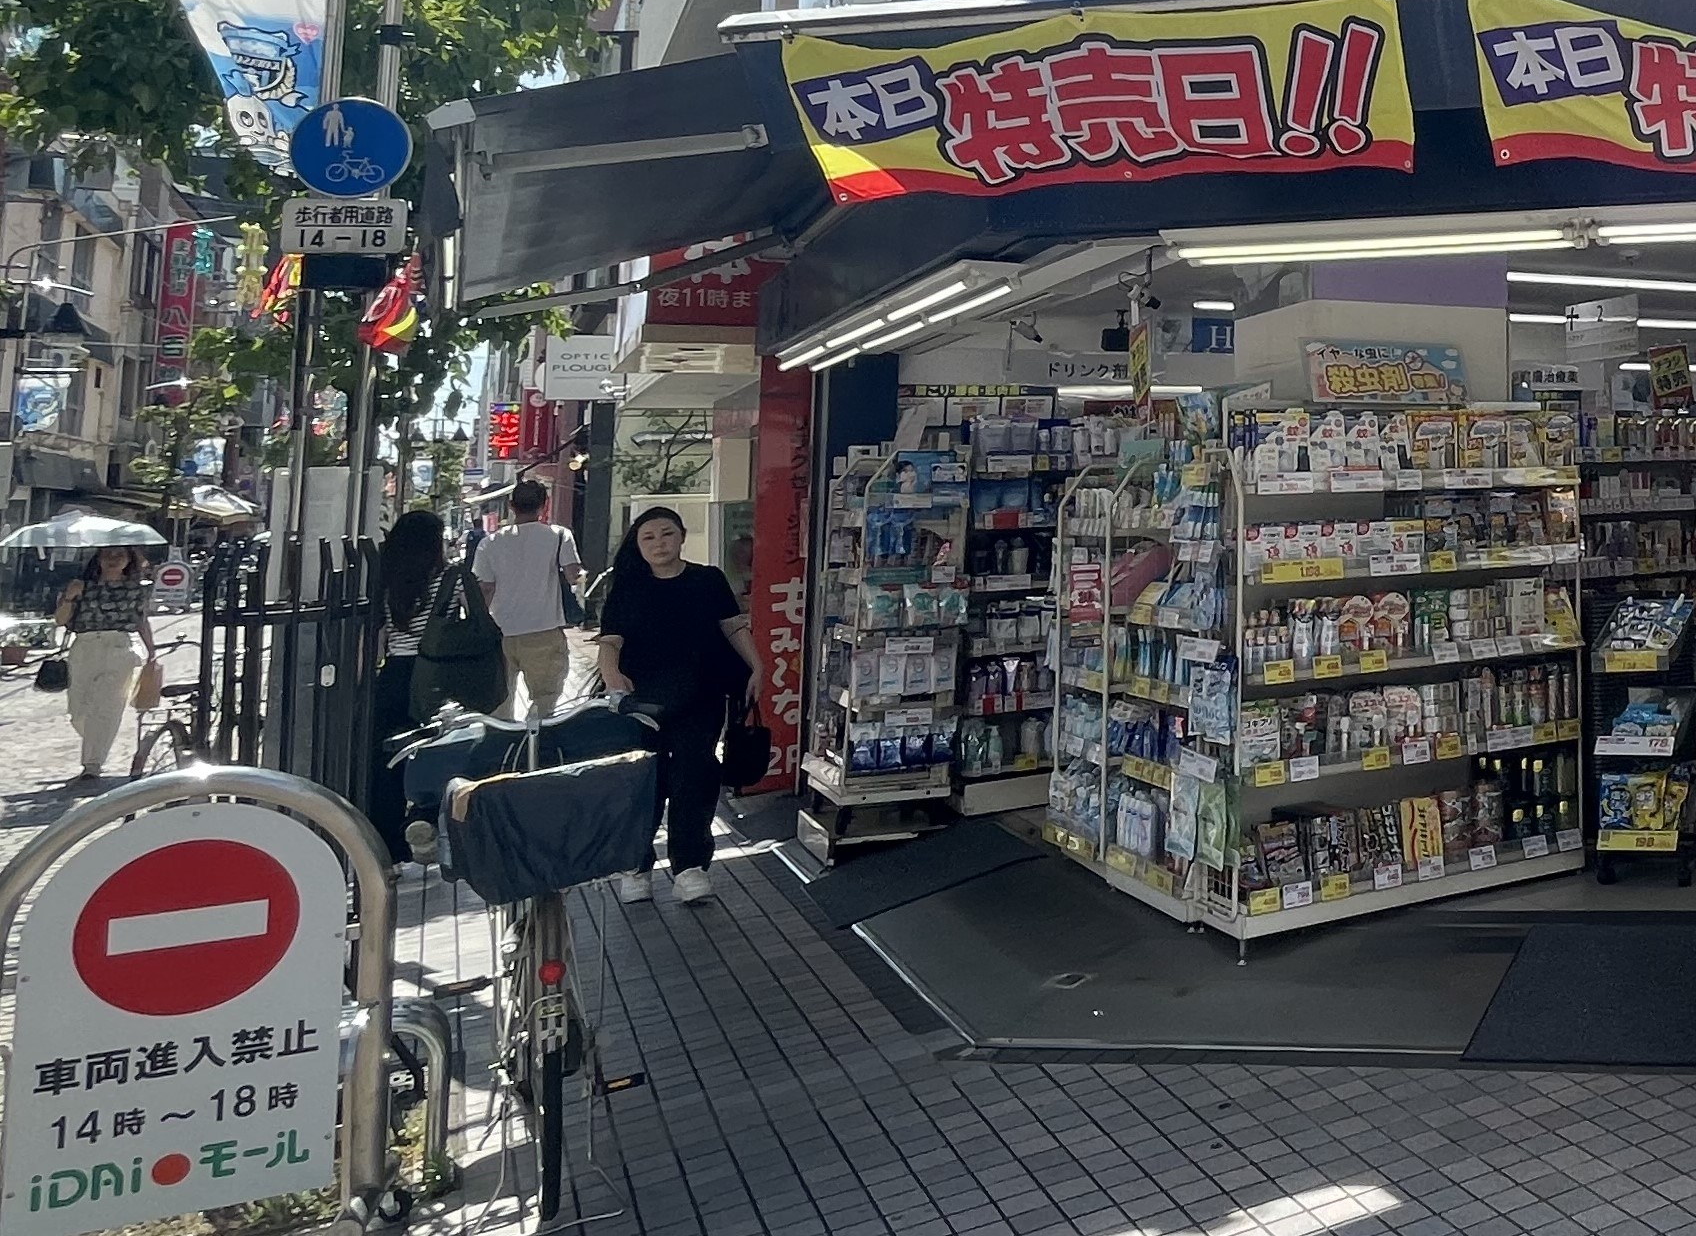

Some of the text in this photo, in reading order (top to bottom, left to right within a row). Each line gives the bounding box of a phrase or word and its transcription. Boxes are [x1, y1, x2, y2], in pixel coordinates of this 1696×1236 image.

[1493, 24, 1626, 95] 本日
[807, 62, 940, 141] 本日
[295, 206, 394, 225] 歩行者用道路
[658, 288, 759, 308] 夜11時ま
[1597, 305, 1604, 322] 2
[1326, 363, 1410, 395] 殺虫剤
[33, 1019, 320, 1096] 車両進入禁止
